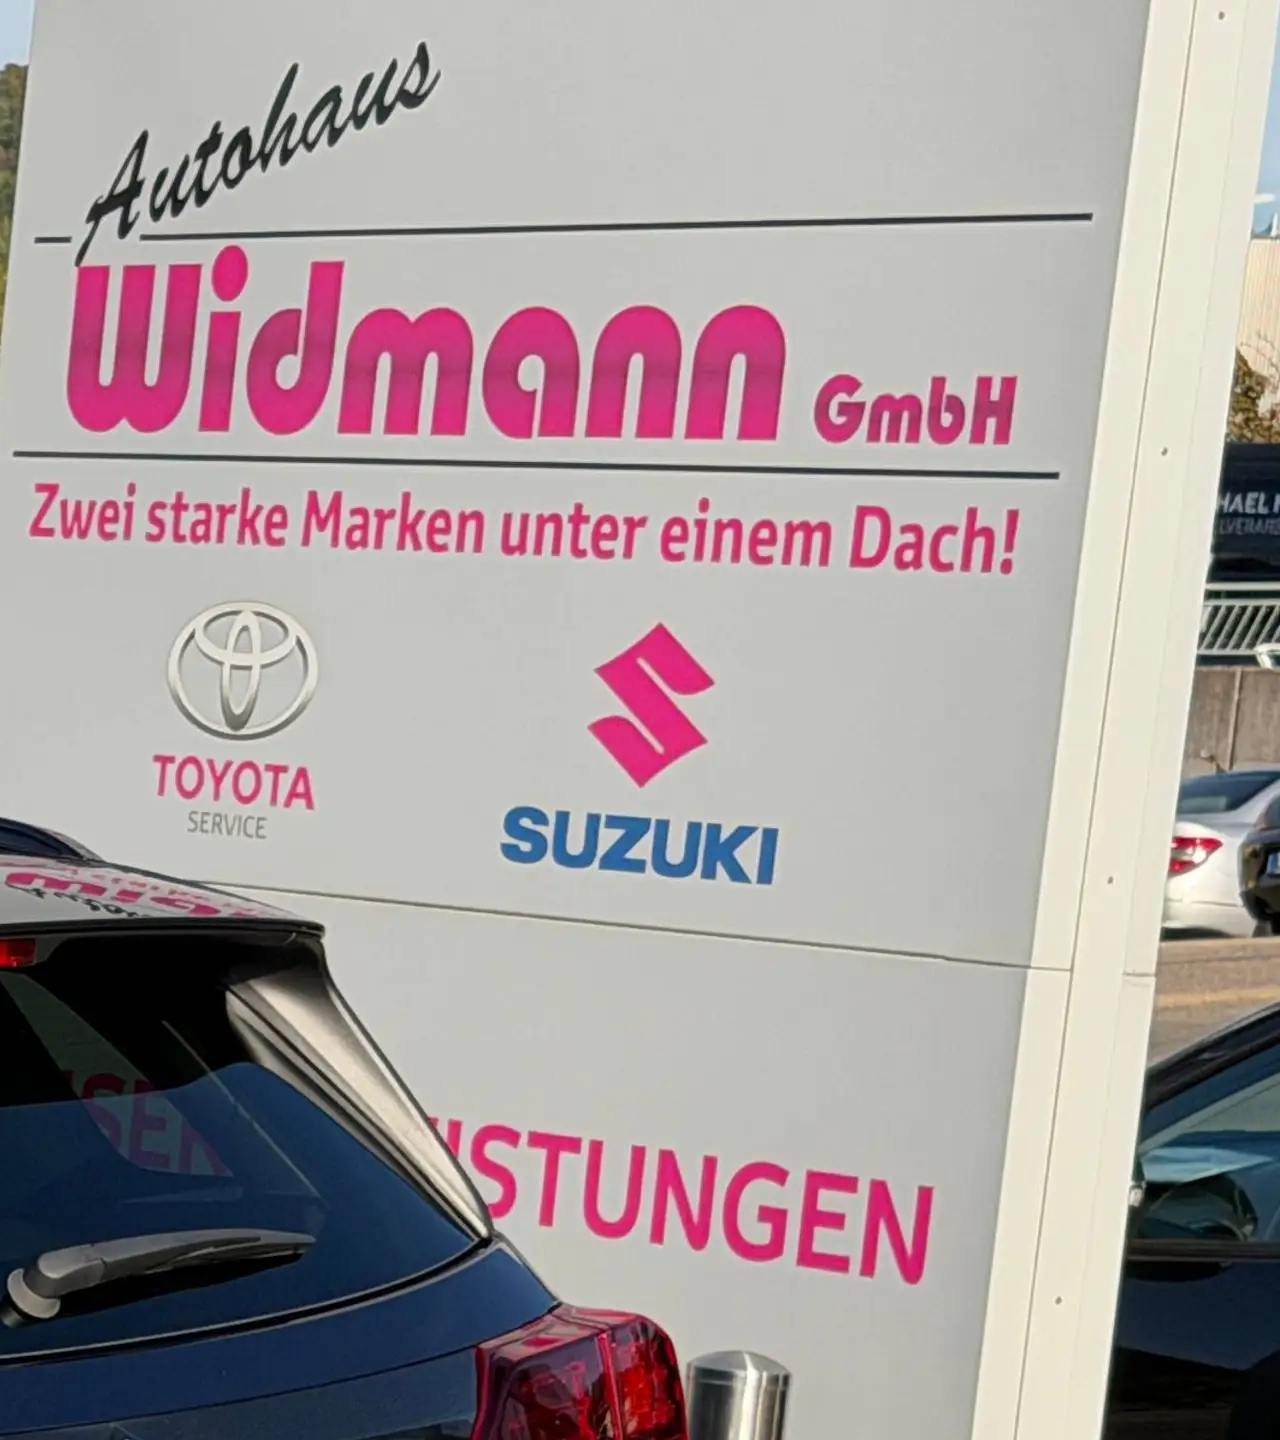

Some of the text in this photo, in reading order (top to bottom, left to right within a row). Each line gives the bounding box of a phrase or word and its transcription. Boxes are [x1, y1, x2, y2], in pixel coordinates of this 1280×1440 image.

[75, 41, 440, 266] Autohaus
[66, 244, 1018, 445] Widmann GmbH
[29, 482, 1019, 575] Zwei starke Marken unter einem Dach!
[152, 754, 315, 811] TOYOTA
[187, 810, 268, 840] SERVICE
[499, 805, 779, 885] SUZUKI
[427, 1116, 934, 1285] STUNGEN
